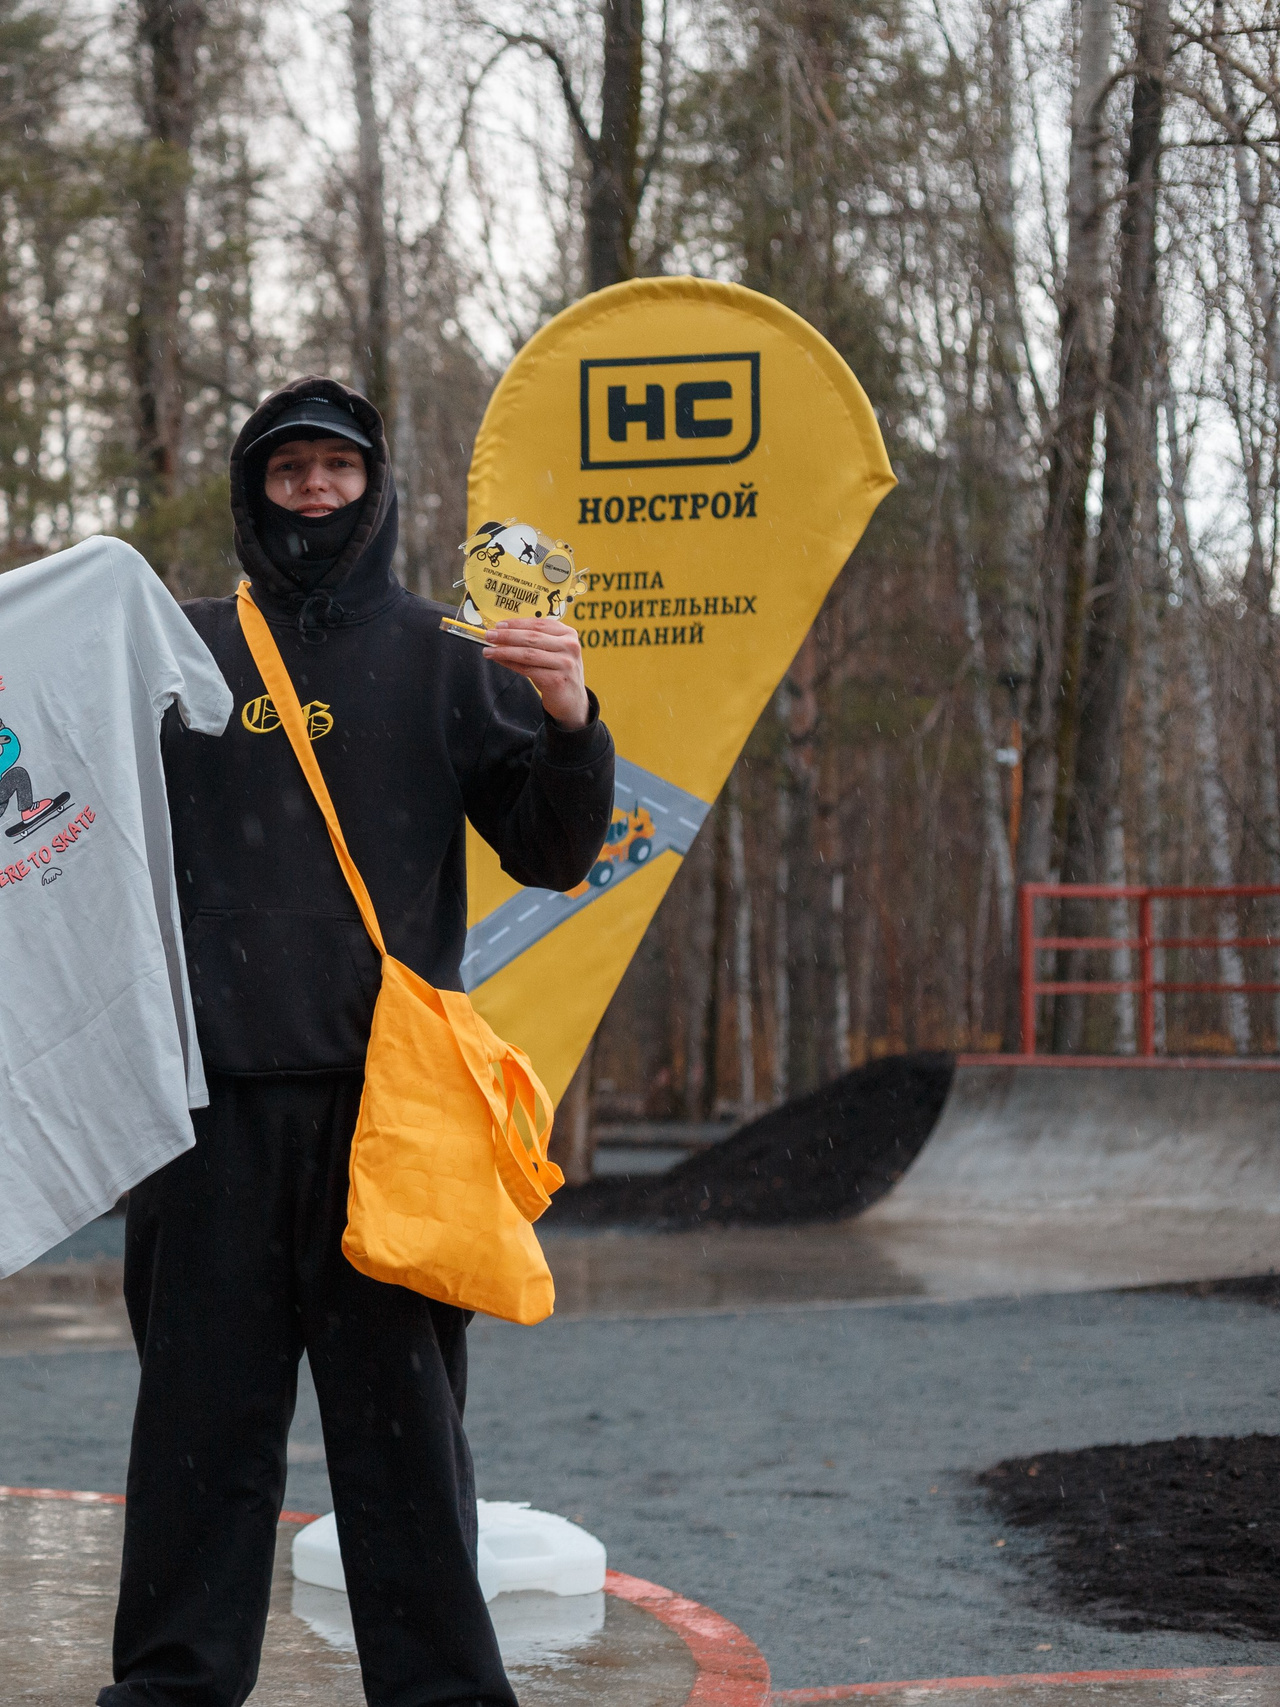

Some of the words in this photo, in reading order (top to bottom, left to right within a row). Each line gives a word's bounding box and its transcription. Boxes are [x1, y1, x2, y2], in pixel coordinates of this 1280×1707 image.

[607, 381, 732, 442] НС
[485, 578, 497, 591] ЗА
[498, 582, 539, 605] ЛУЧШИЙ
[495, 594, 521, 613] ТРЮК
[573, 595, 757, 620] СТРОИТЕЛЬНЫХ
[27, 845, 52, 869] TO
[51, 804, 96, 853] SKATE
